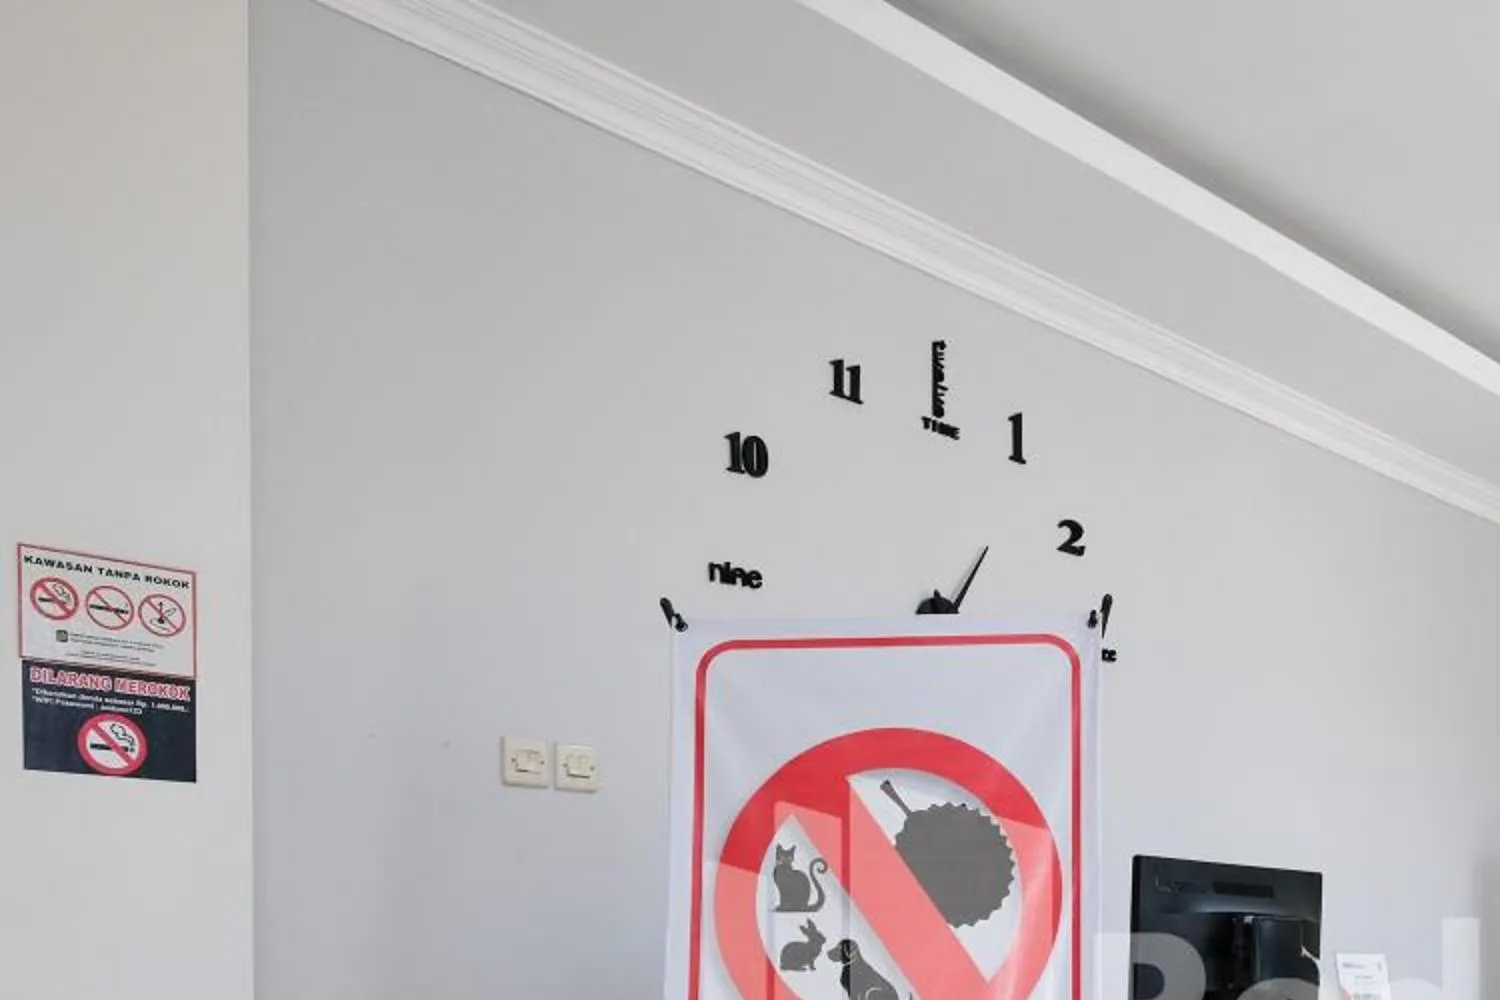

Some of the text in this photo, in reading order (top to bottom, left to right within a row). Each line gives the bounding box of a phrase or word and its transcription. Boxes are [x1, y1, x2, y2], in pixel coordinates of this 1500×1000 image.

[829, 358, 864, 405] 11
[724, 431, 769, 478] 10
[1008, 412, 1027, 465] 1
[1056, 519, 1086, 557] 2
[23, 555, 189, 589] KAWASAN TANPA ROKOK
[30, 666, 191, 702] DILARANG MEROKOK
